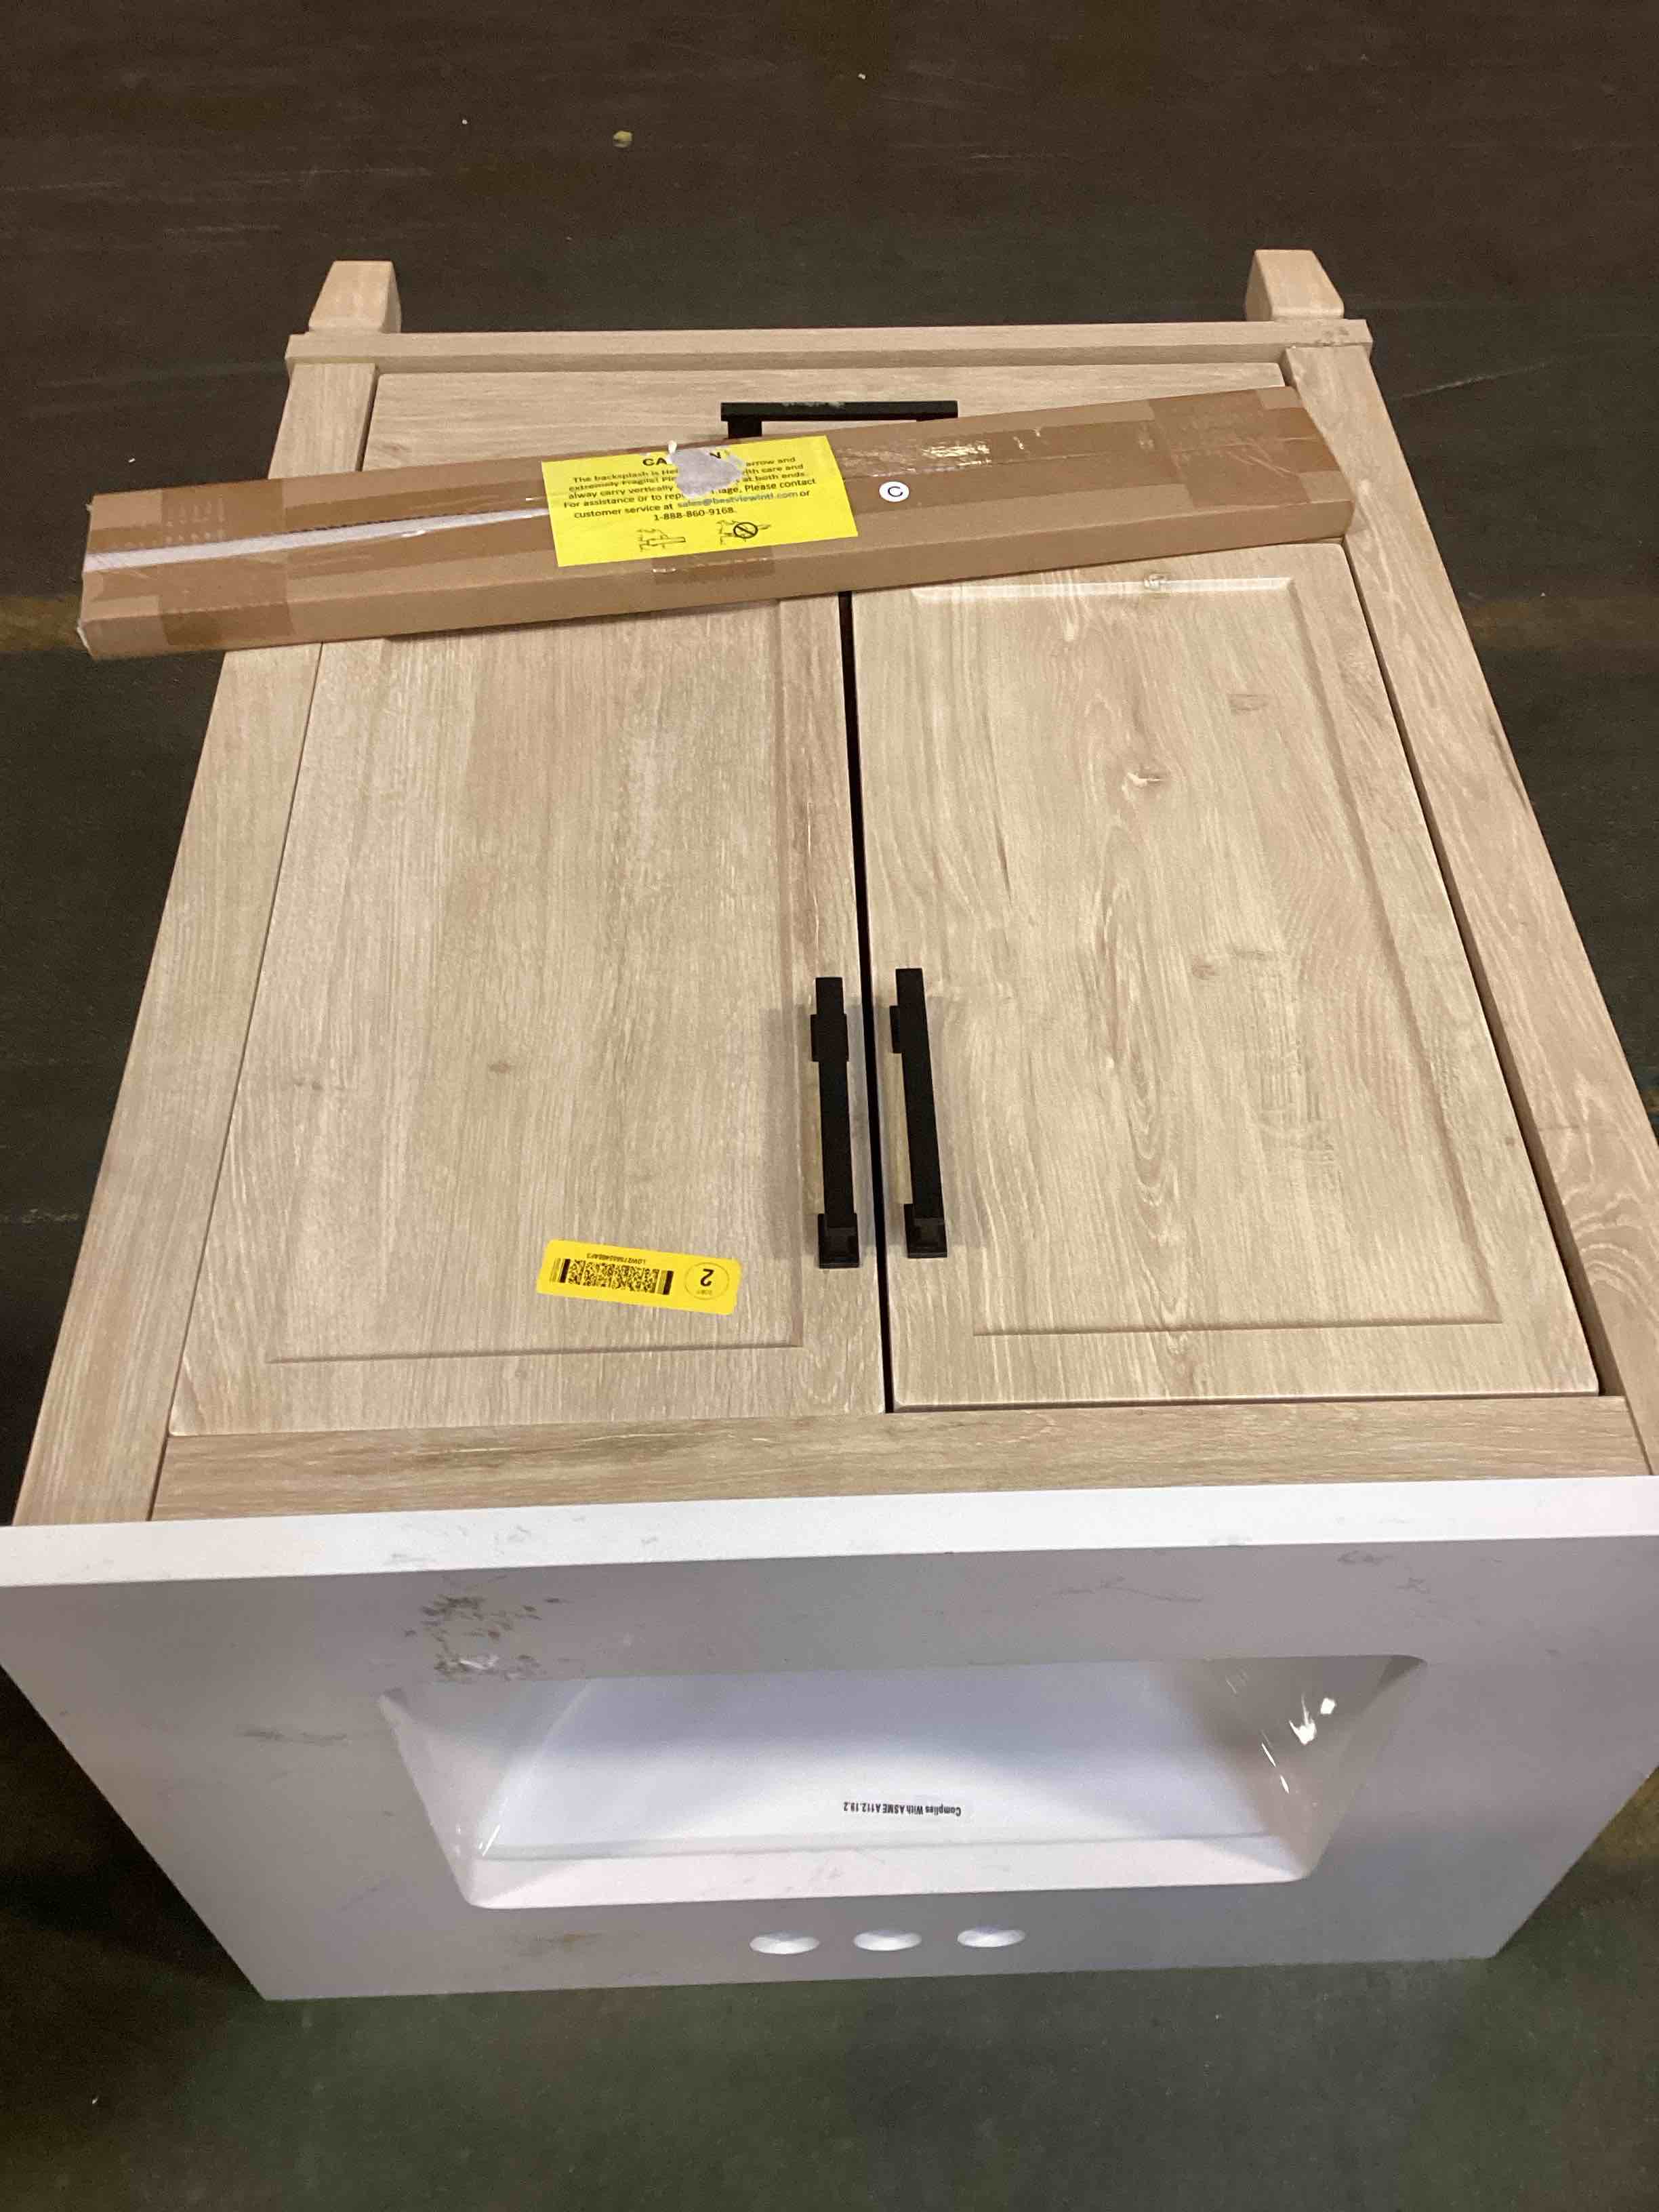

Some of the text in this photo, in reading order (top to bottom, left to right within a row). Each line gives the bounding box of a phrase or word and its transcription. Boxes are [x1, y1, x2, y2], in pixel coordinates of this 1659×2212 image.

[777, 457, 796, 465] and
[594, 471, 649, 481] backsplash
[569, 481, 619, 491] extremely
[744, 483, 777, 492] Please
[779, 478, 816, 489] contact
[569, 485, 674, 499] alway carry vertically
[888, 486, 903, 497] C
[583, 497, 635, 507] assistance
[574, 509, 621, 518] customer
[624, 504, 661, 513] service
[700, 1269, 715, 1287] 2
[843, 1801, 961, 1817] Complies With ASME A112.19.2
